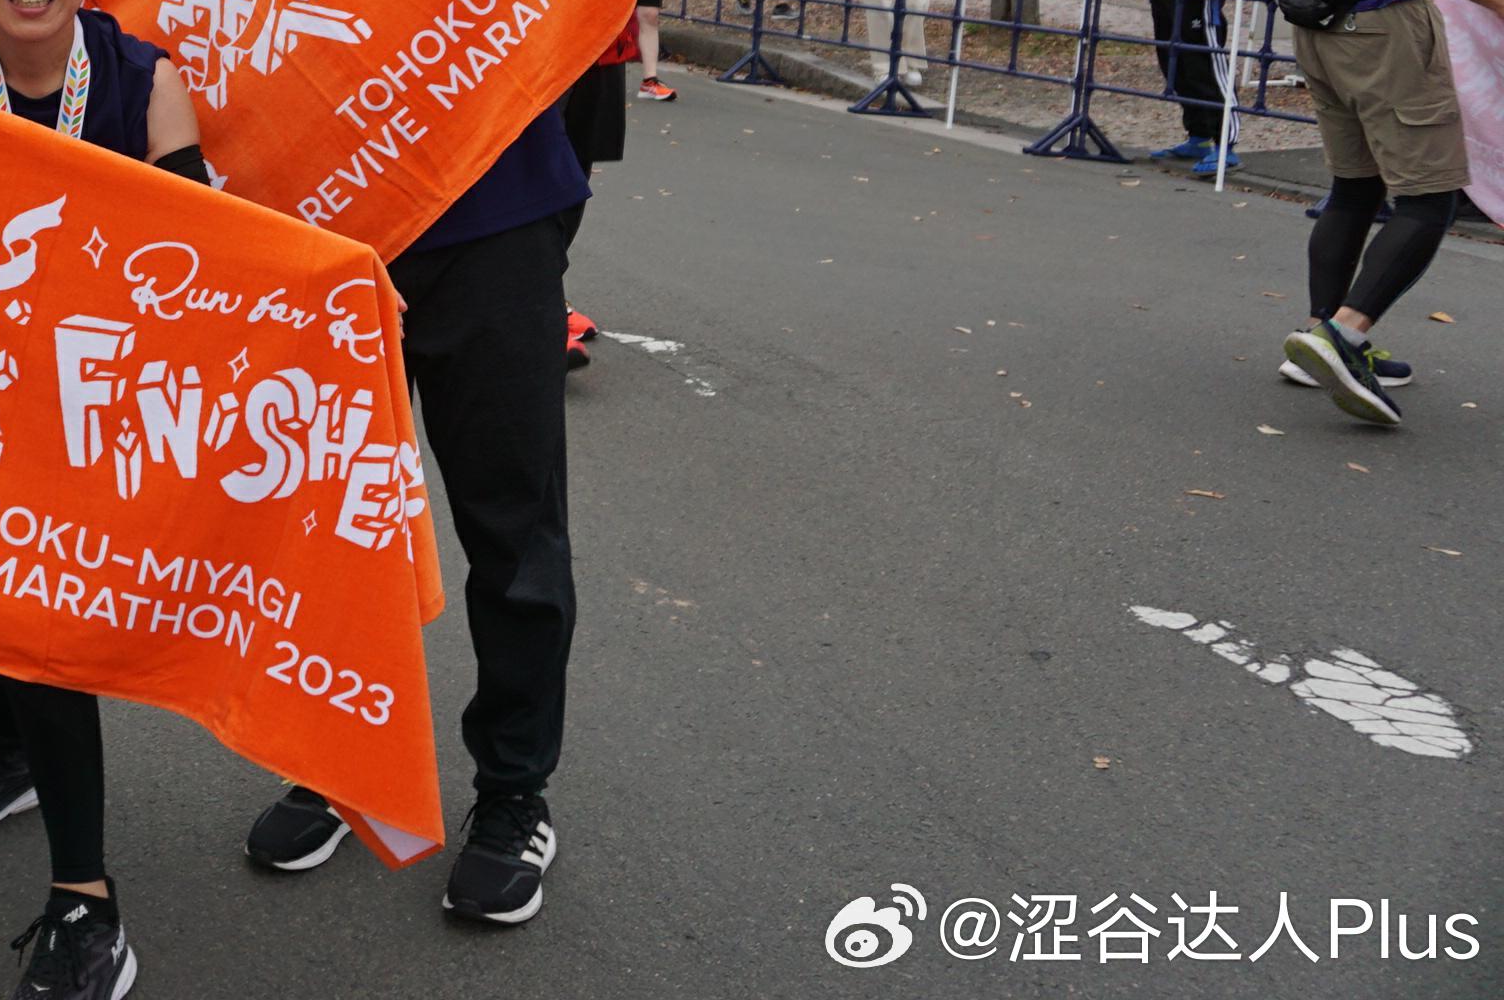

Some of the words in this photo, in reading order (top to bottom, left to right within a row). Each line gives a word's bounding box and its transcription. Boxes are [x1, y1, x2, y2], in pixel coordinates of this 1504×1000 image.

[296, 105, 430, 228] REVIVE
[122, 240, 244, 321] Run
[246, 287, 318, 330] for
[264, 641, 396, 727] 2023
